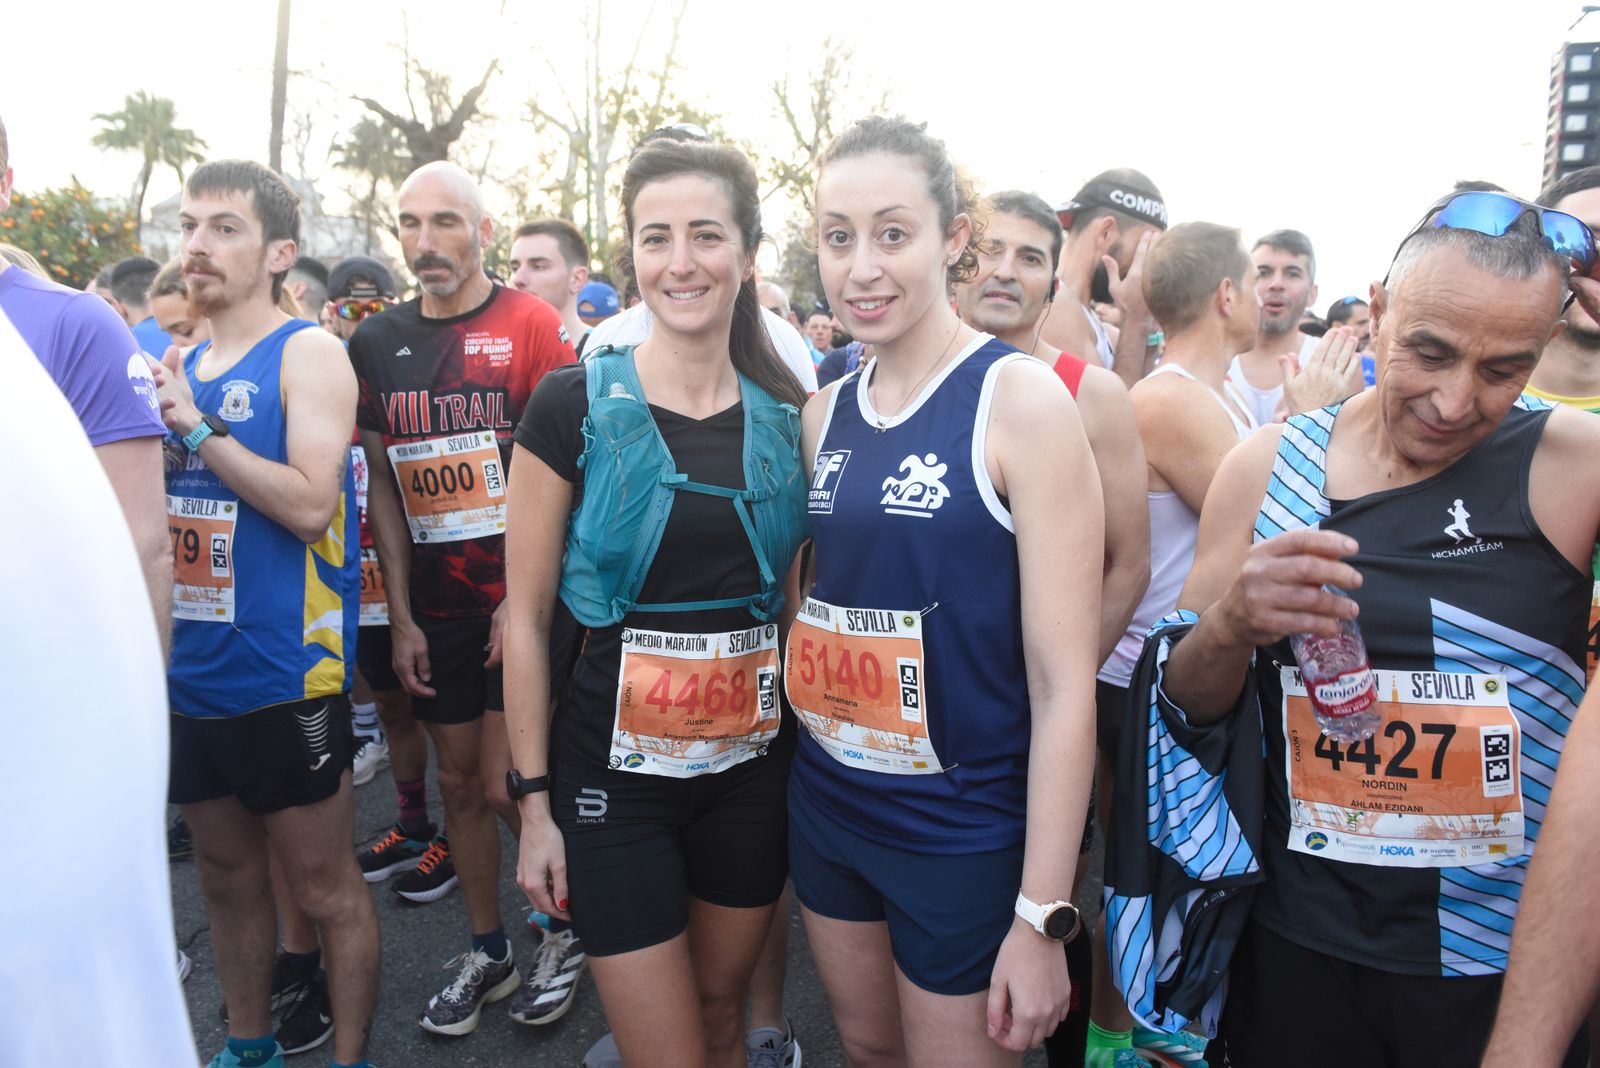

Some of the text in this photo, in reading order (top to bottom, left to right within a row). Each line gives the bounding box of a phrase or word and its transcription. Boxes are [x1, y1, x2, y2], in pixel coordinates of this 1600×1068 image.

[464, 345, 481, 355] TOP
[381, 389, 511, 435] VIII TRAIL
[448, 435, 480, 452] SEVILLA
[412, 462, 474, 497] 4000
[181, 498, 218, 516] SEVILLA
[1431, 542, 1504, 559] HICHAMTEAM
[846, 609, 897, 633] SEVILLA
[635, 633, 708, 652] MEDIO MARATÓN
[729, 628, 761, 654] SEVILLA
[800, 638, 884, 699] 5140
[645, 669, 749, 716] 4468
[1411, 672, 1476, 701] SEVILLA
[684, 718, 714, 726] Justine
[844, 748, 865, 761] HOKA
[1293, 737, 1301, 762] CAJÓN
[1314, 720, 1457, 780] 4427
[686, 762, 710, 771] HOKA
[1362, 779, 1408, 792] NORDIN
[1350, 799, 1424, 813] AHLAM EZIDANI
[1380, 845, 1415, 857] HOKA
